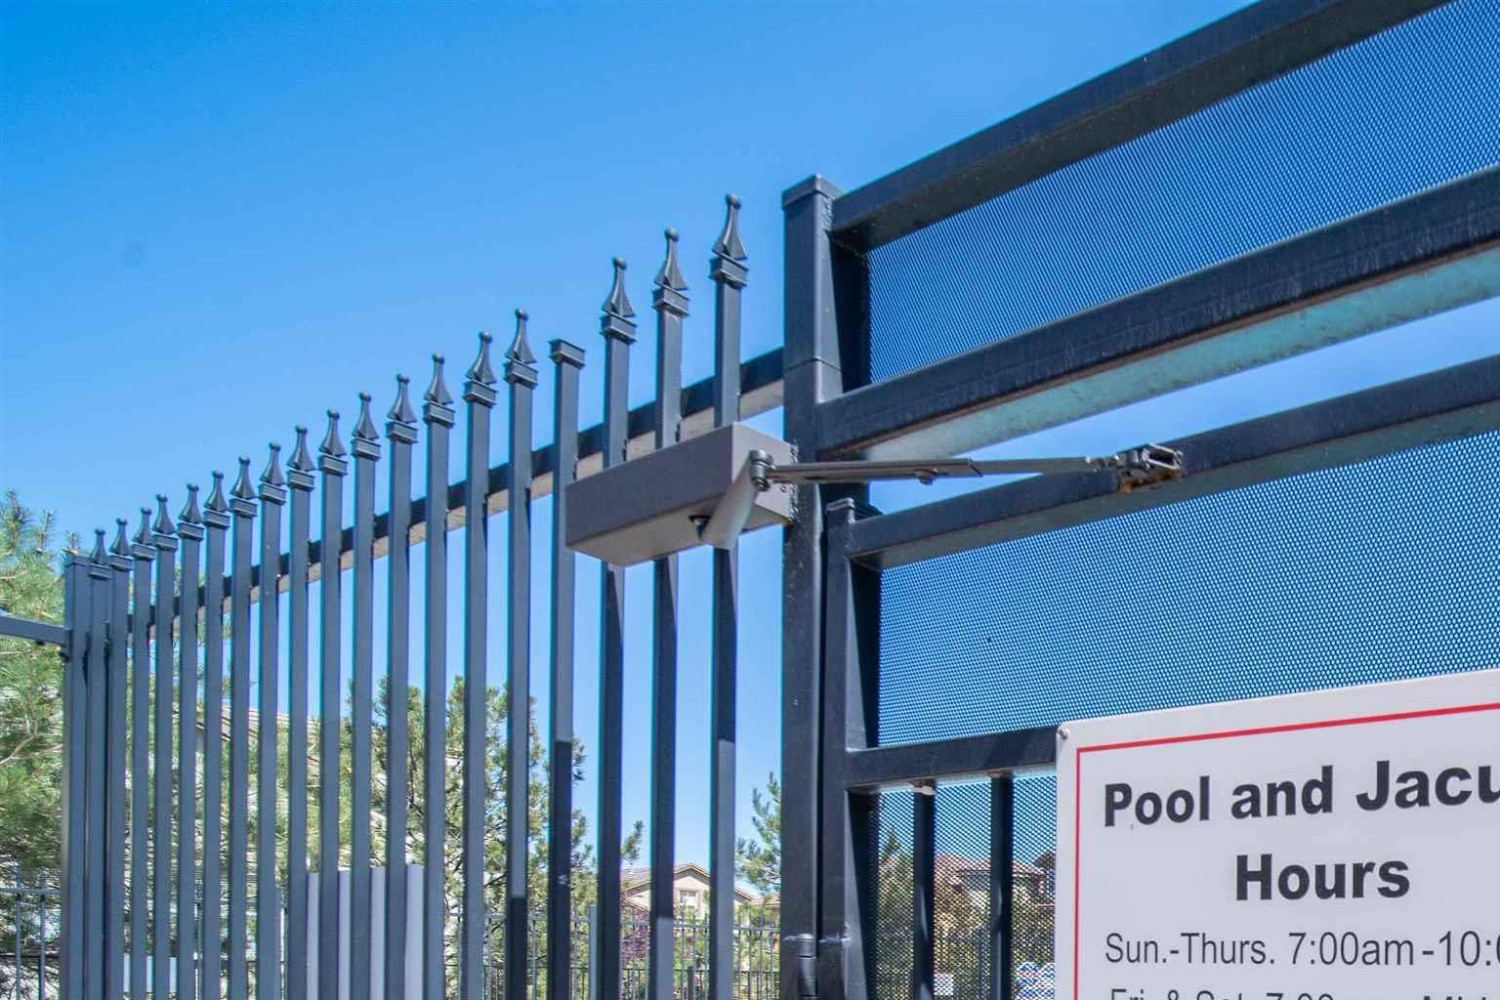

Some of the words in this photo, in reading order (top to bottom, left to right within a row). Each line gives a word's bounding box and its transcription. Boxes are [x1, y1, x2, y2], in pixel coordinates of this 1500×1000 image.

[1105, 775, 1210, 827] Pool
[1231, 765, 1333, 819] and
[1236, 853, 1410, 901] Hours
